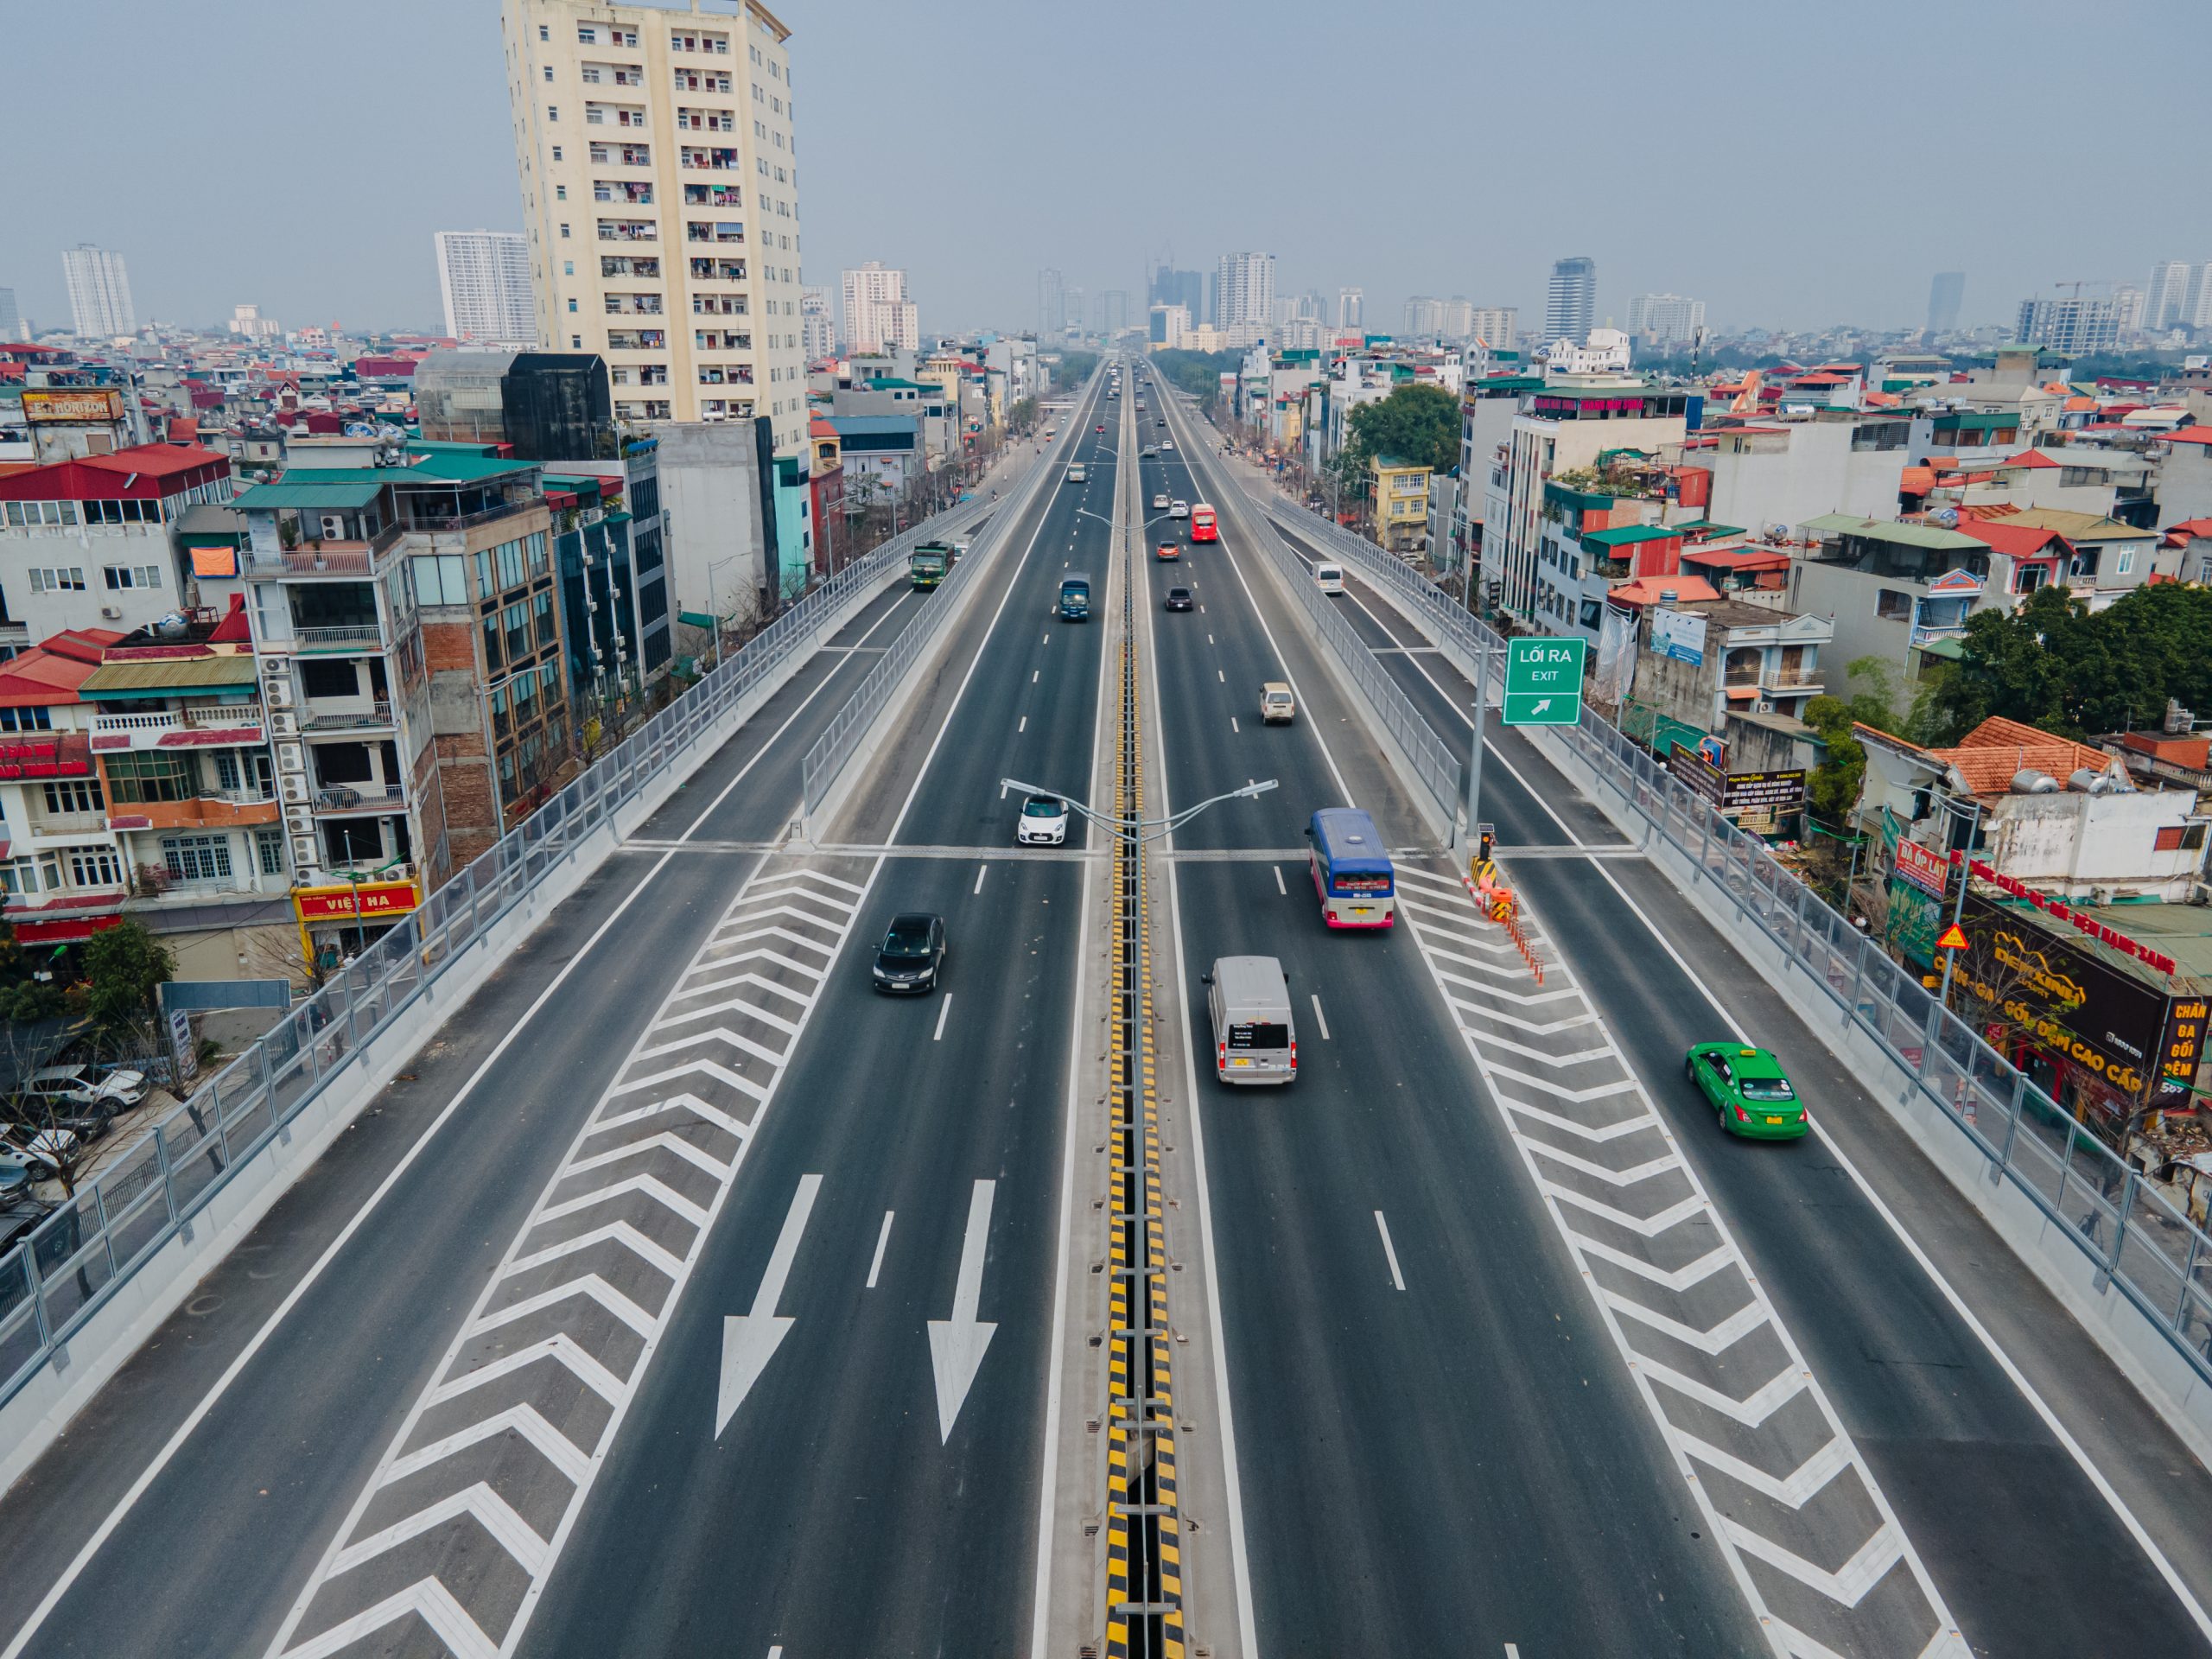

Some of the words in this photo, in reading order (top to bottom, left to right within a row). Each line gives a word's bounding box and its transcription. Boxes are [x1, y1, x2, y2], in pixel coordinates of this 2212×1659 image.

[55, 402, 108, 415] HORIZON
[1520, 644, 1544, 663] LỐI
[1548, 649, 1572, 663] RA
[1531, 671, 1559, 681] EXIT
[1915, 849, 1928, 868] ỐP
[1929, 859, 1946, 879] LÁT
[2139, 945, 2176, 976] SANG
[2176, 1002, 2207, 1018] CHĂN
[2177, 1024, 2195, 1038] GA
[2171, 1040, 2194, 1058] GỐI
[2071, 1043, 2105, 1071] CAO
[2107, 1065, 2143, 1093] CẤP
